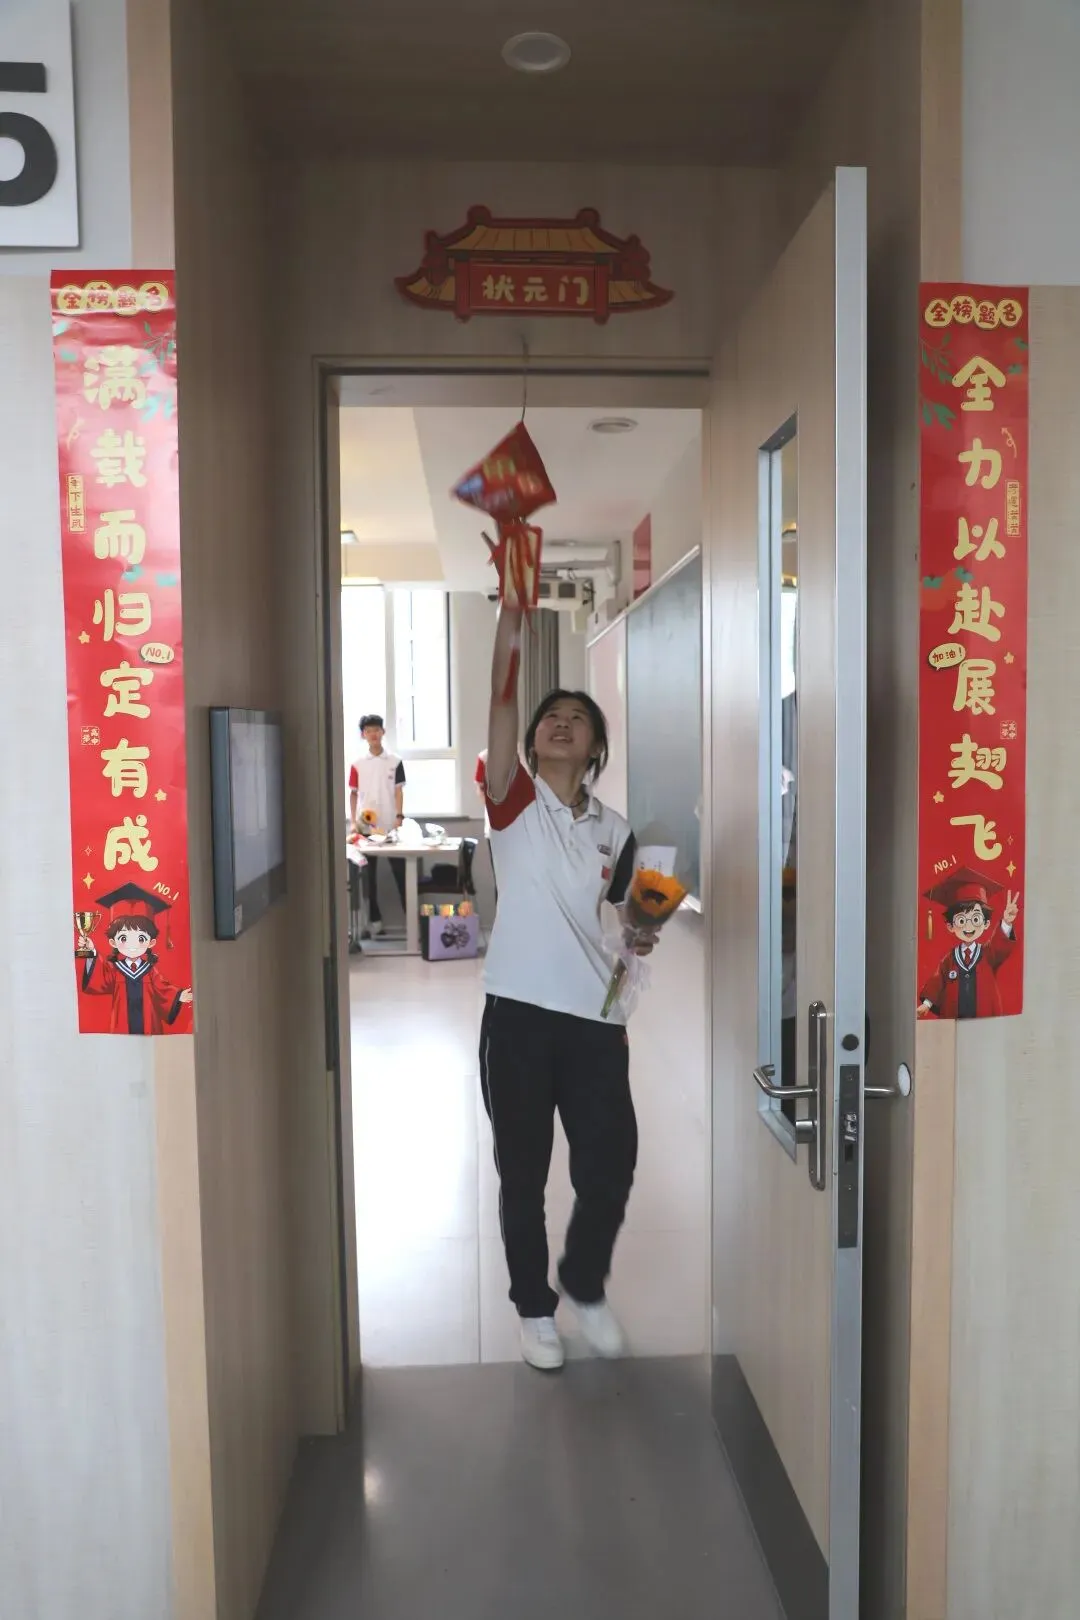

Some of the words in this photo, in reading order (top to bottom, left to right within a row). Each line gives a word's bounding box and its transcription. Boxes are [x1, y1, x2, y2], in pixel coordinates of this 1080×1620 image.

[481, 274, 589, 305] 状元门
[83, 345, 159, 872] 满载而归定有成
[947, 355, 1007, 861] 全力以赴展翅飞
[144, 646, 171, 661] NO.1
[934, 855, 957, 874] NO.1
[153, 881, 179, 901] NO.1
